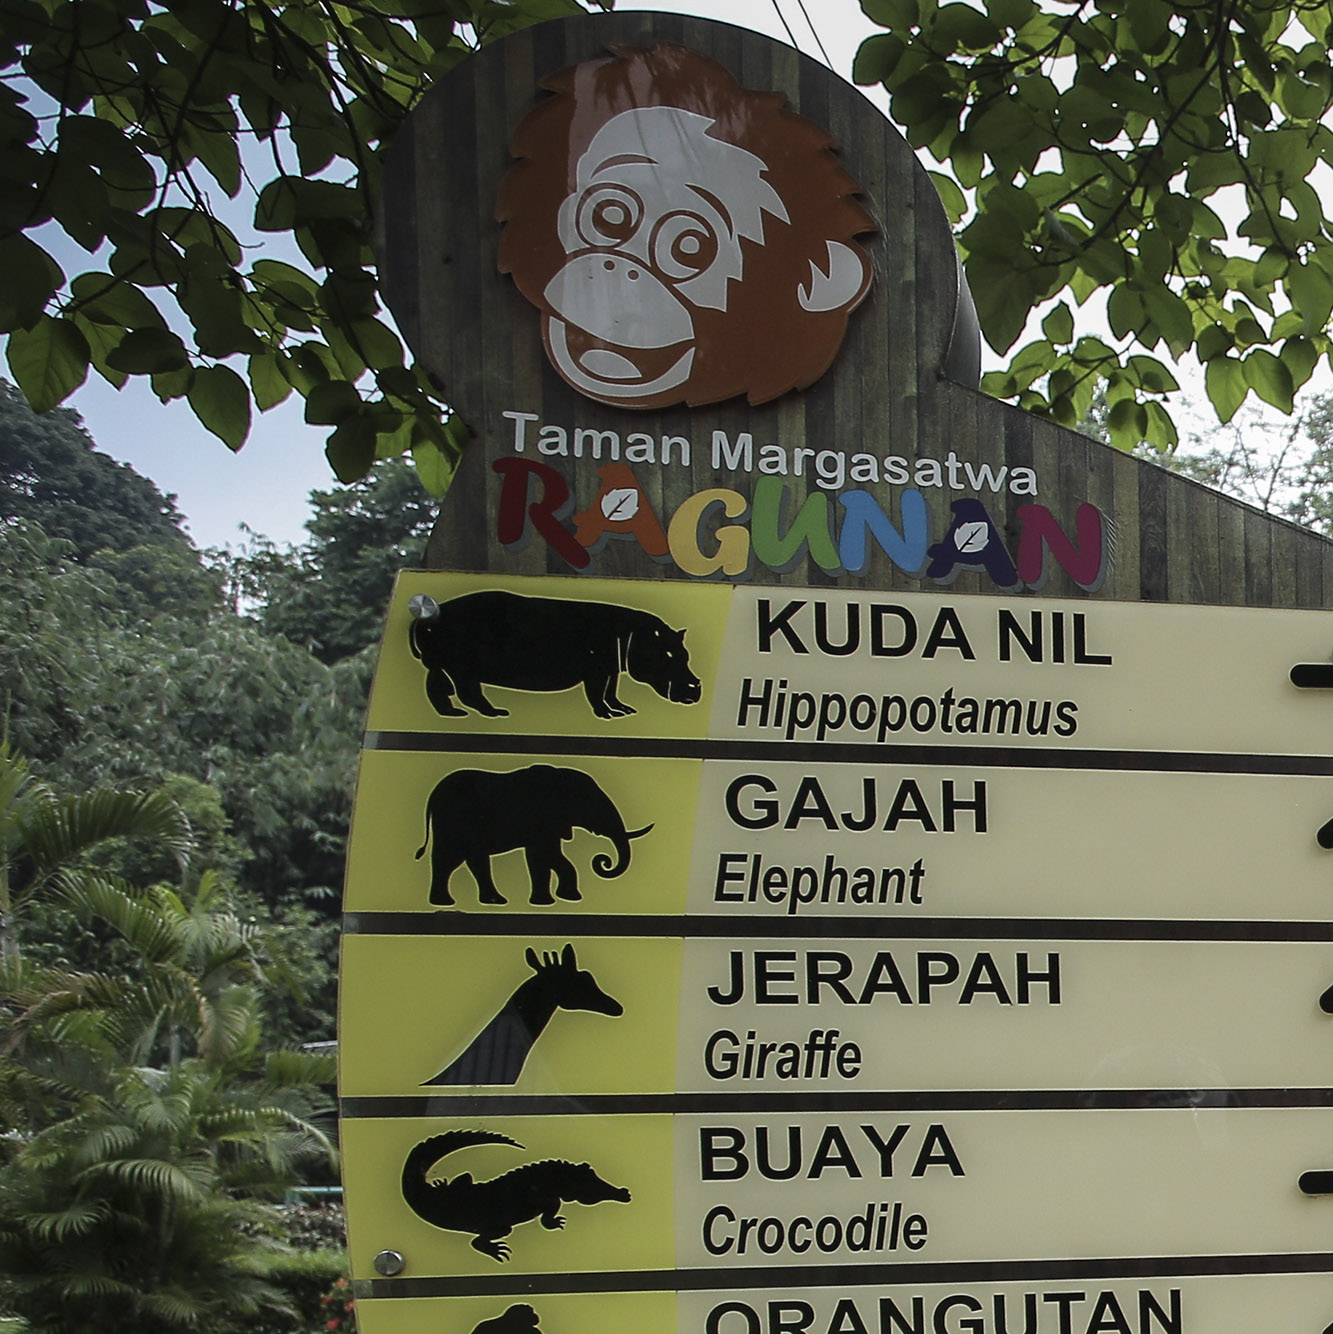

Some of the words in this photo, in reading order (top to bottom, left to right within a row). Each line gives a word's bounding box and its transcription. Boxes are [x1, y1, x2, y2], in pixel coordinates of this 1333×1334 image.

[504, 411, 690, 467] Taman
[709, 430, 1040, 497] Margasatwa
[493, 457, 1105, 585] RAGUNAN
[757, 599, 976, 661] KUDA
[998, 609, 1113, 666] NIL
[737, 678, 1079, 743] Hippopotamus
[725, 774, 987, 833] GAJAH
[714, 853, 926, 915] Elephant
[707, 951, 1061, 1006] JERAPAH
[704, 1029, 862, 1080] Giraffe
[699, 1124, 966, 1181] BUAYA
[702, 1202, 928, 1256] Crocodile
